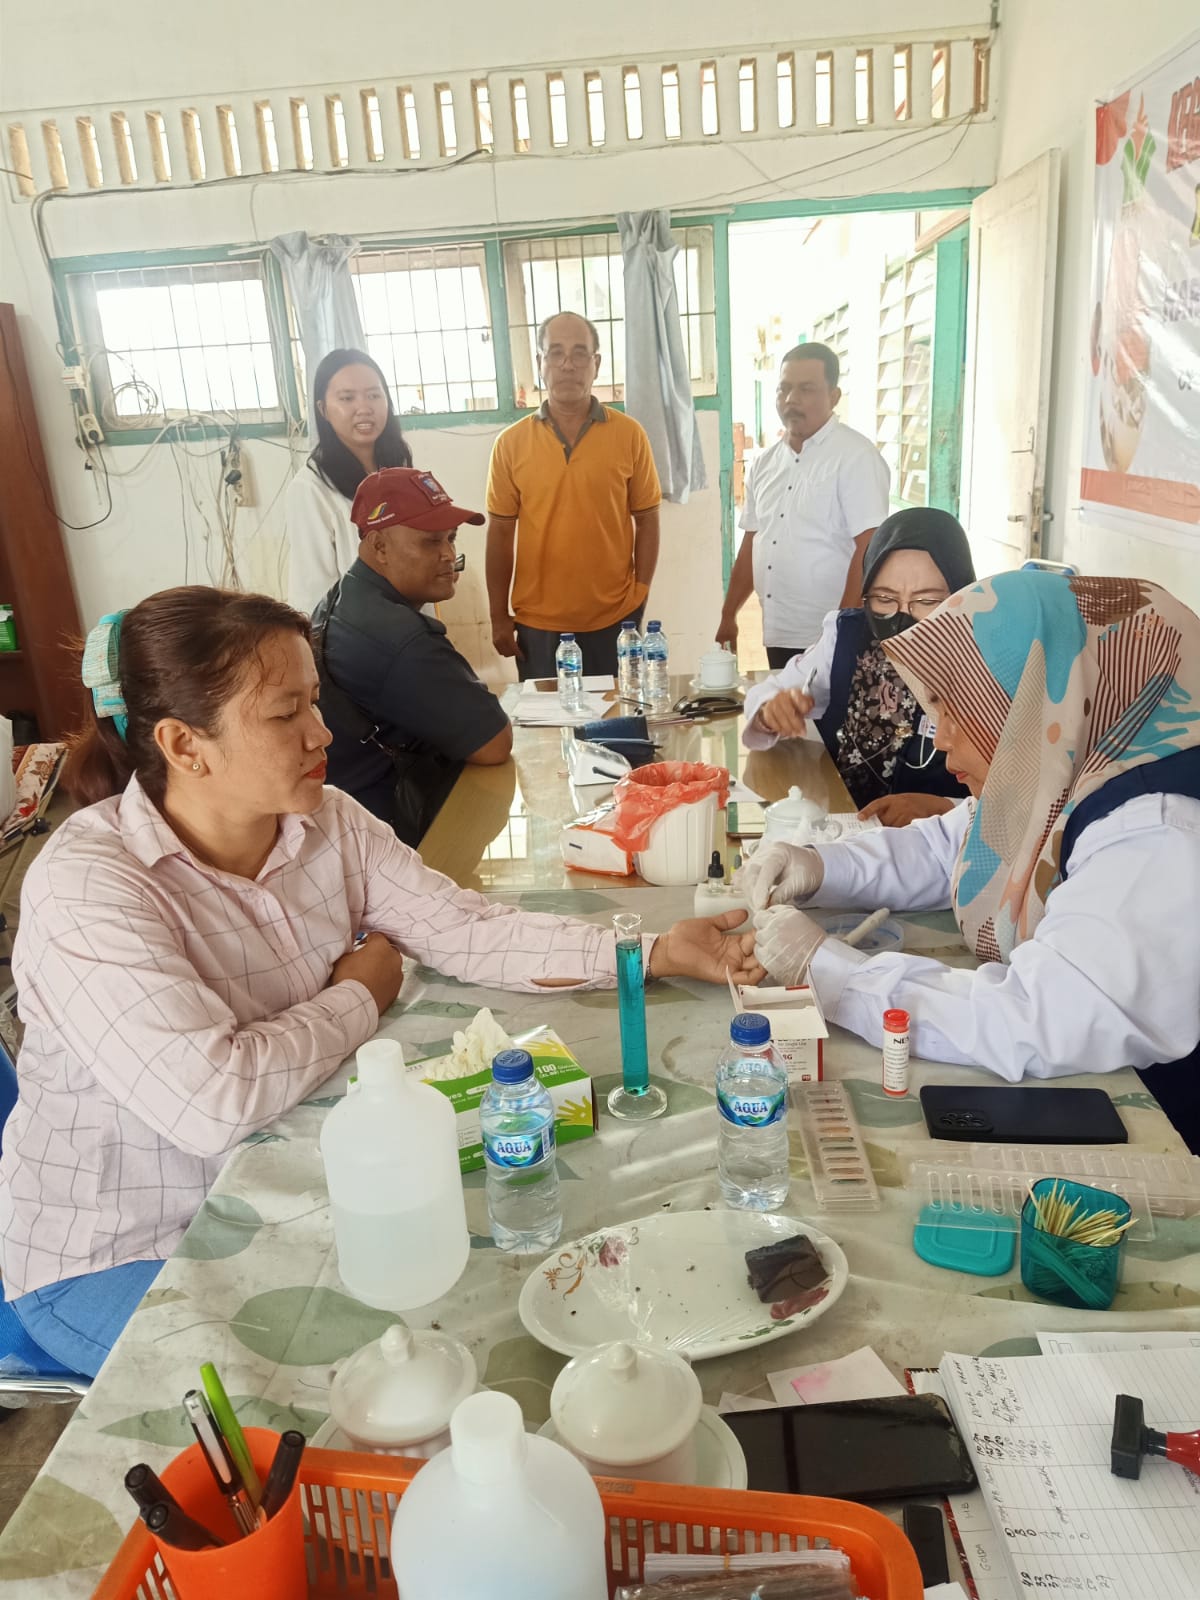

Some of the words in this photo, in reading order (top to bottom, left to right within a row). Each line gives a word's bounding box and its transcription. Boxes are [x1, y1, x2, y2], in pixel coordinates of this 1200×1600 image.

[536, 1063, 557, 1074] 100
[734, 1101, 769, 1116] AQUA
[497, 1141, 532, 1155] AQUA
